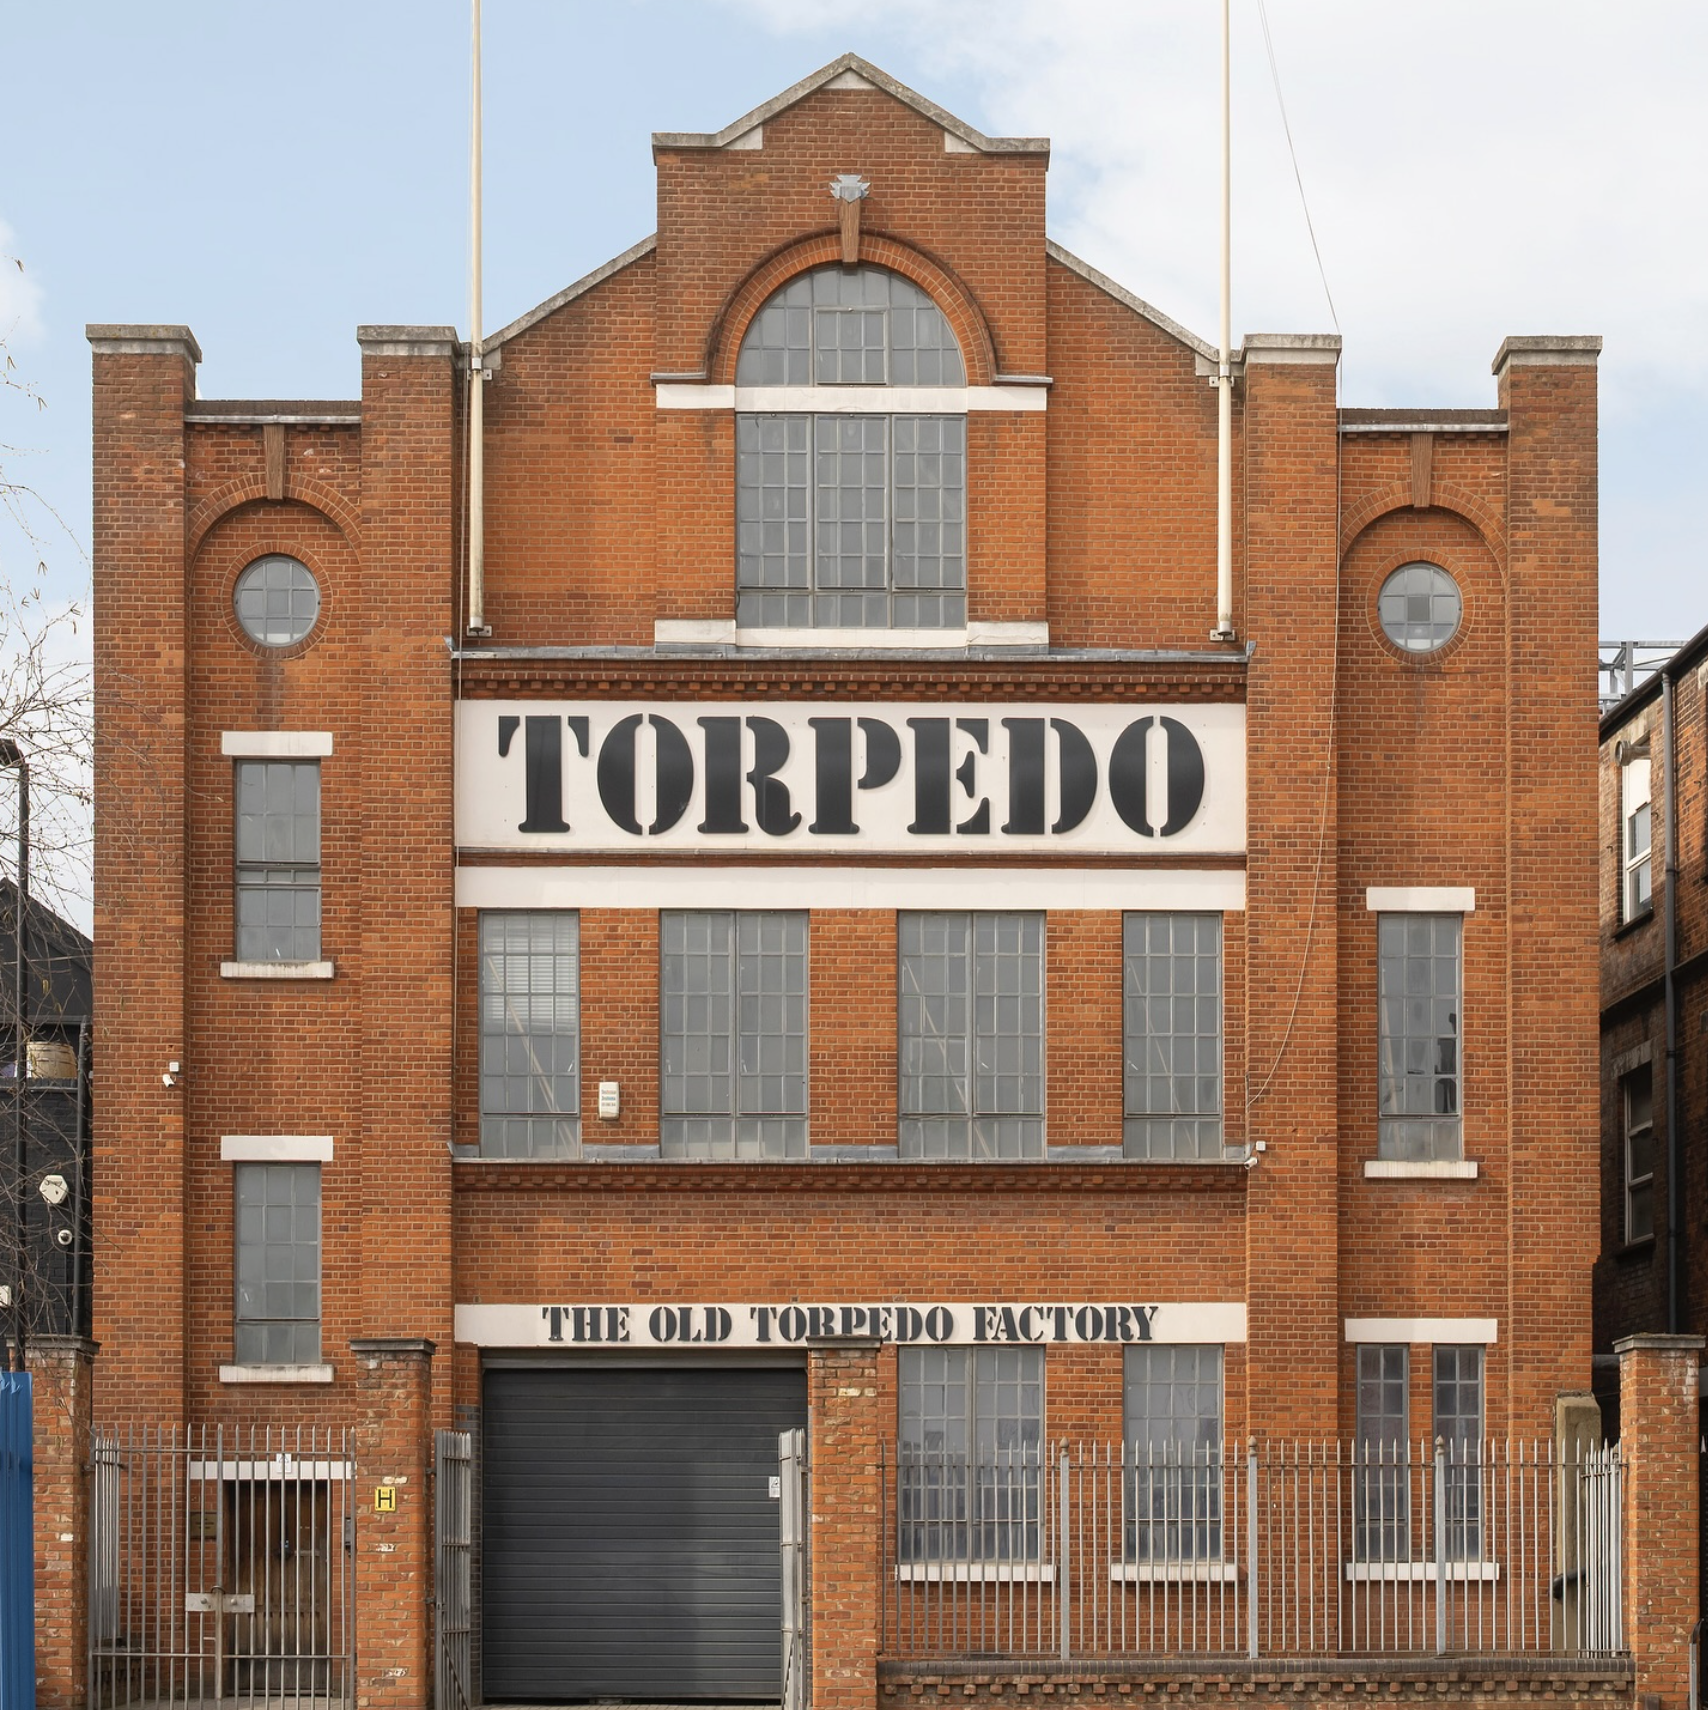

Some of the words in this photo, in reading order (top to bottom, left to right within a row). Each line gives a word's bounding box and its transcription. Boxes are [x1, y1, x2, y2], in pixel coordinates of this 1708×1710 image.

[498, 713, 1205, 837] TORPEDO
[542, 1306, 630, 1342] THE
[649, 1306, 732, 1342] OLD
[750, 1306, 954, 1342] TORPEDO
[973, 1306, 1159, 1342] FACTORY
[378, 1489, 392, 1508] H
